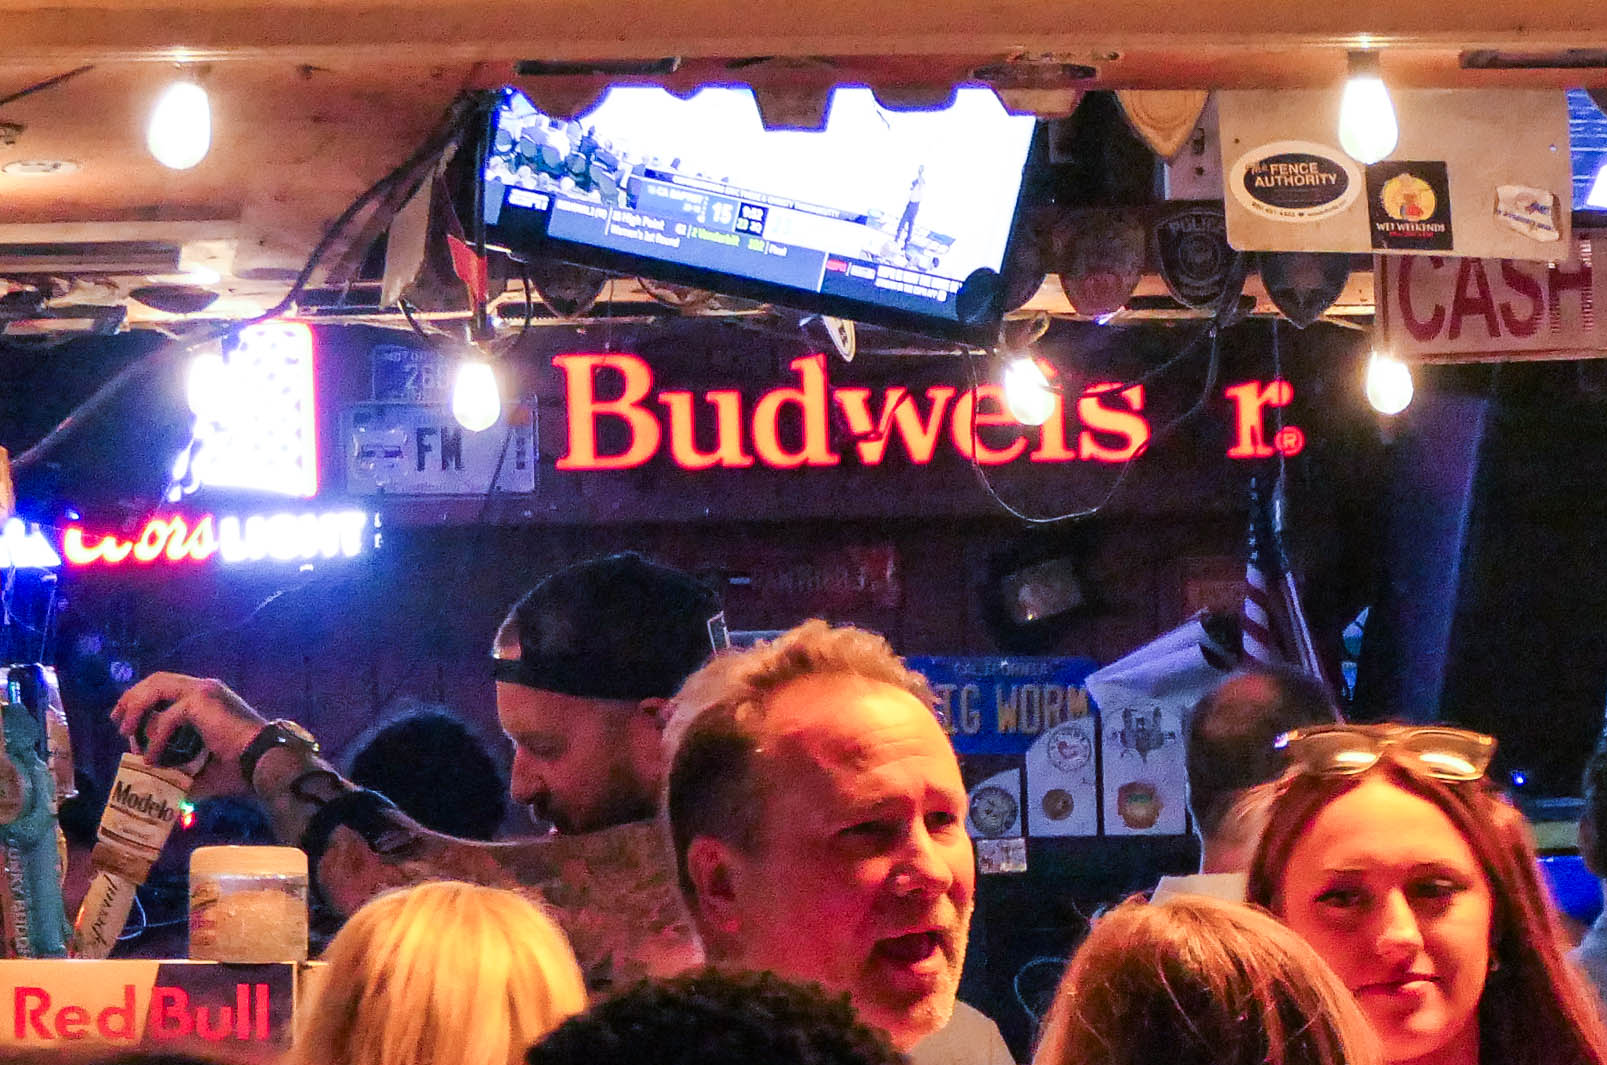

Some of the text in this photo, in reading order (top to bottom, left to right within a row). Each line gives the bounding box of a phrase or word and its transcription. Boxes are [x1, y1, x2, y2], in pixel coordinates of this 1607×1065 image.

[1255, 173, 1337, 188] AUTHORITY
[1270, 161, 1319, 176] FENCE
[1399, 235, 1593, 342] CASH
[551, 351, 1295, 471] Budweisr
[934, 683, 982, 735] IG
[113, 780, 175, 822] Modelo
[14, 983, 271, 1041] Red Bull
